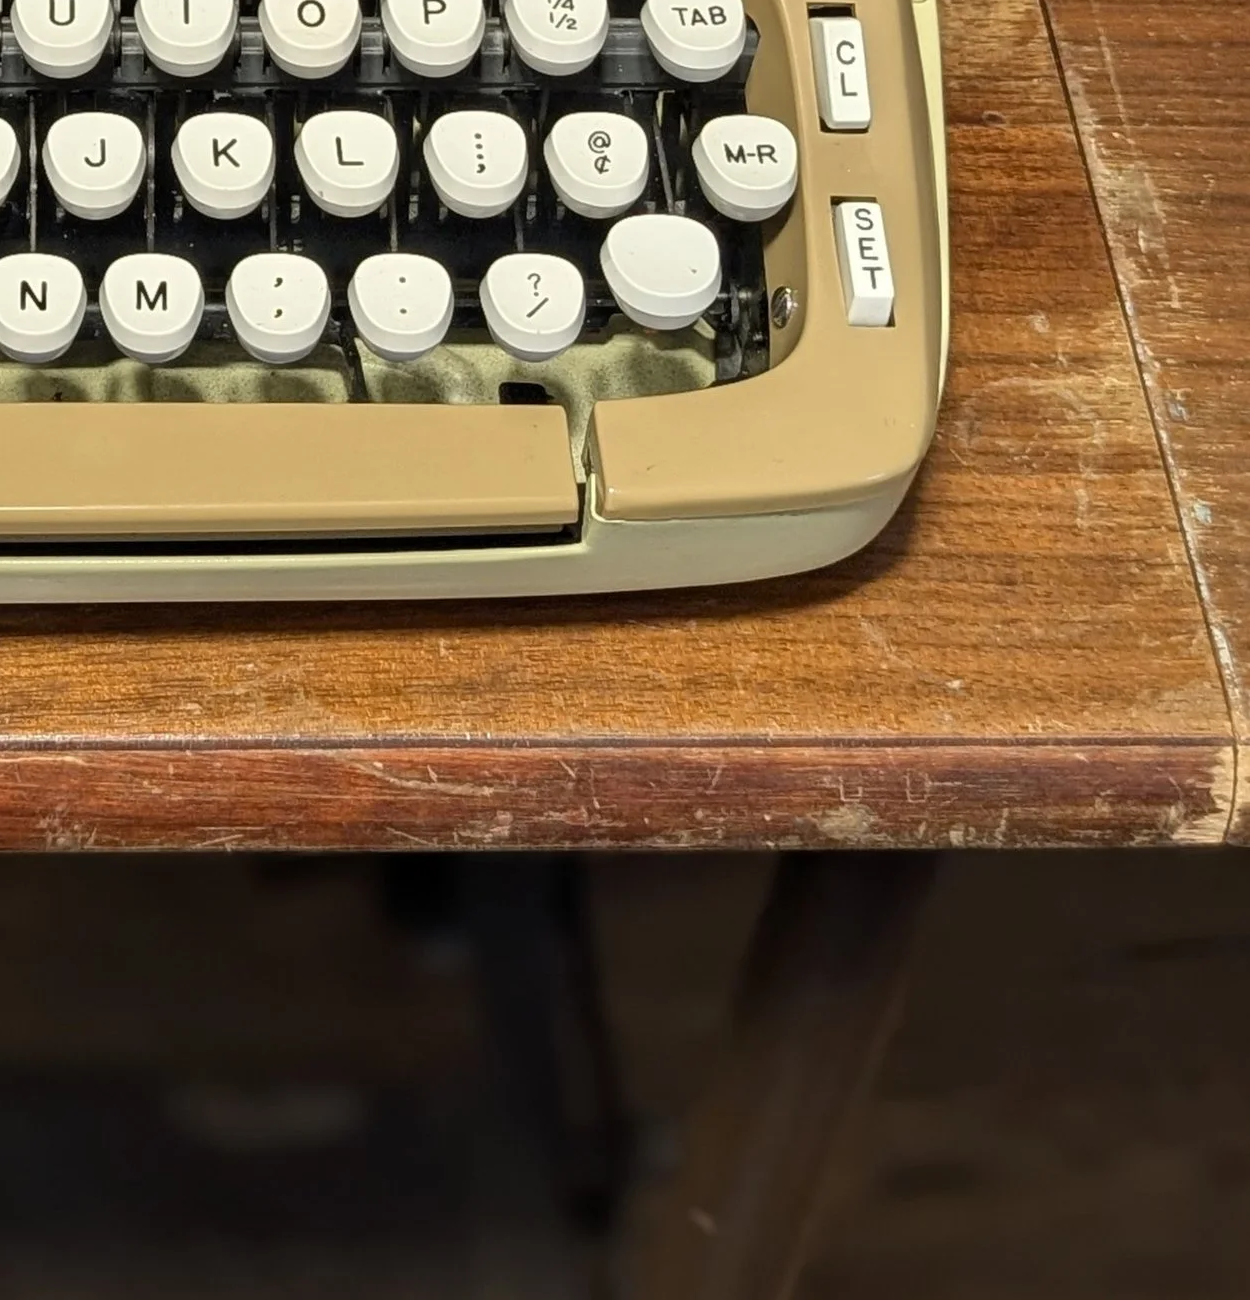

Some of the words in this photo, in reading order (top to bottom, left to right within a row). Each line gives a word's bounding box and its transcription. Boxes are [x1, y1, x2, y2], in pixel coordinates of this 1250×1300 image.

[297, 0, 326, 28] O
[671, 5, 727, 27] TAB
[84, 138, 106, 168] J
[212, 138, 240, 168] K
[335, 136, 365, 167] L
[587, 130, 612, 152] @
[723, 143, 778, 165] M-R
[591, 151, 611, 175] ¢
[20, 280, 48, 312] N
[135, 280, 168, 311] M
[527, 272, 542, 297] ?
